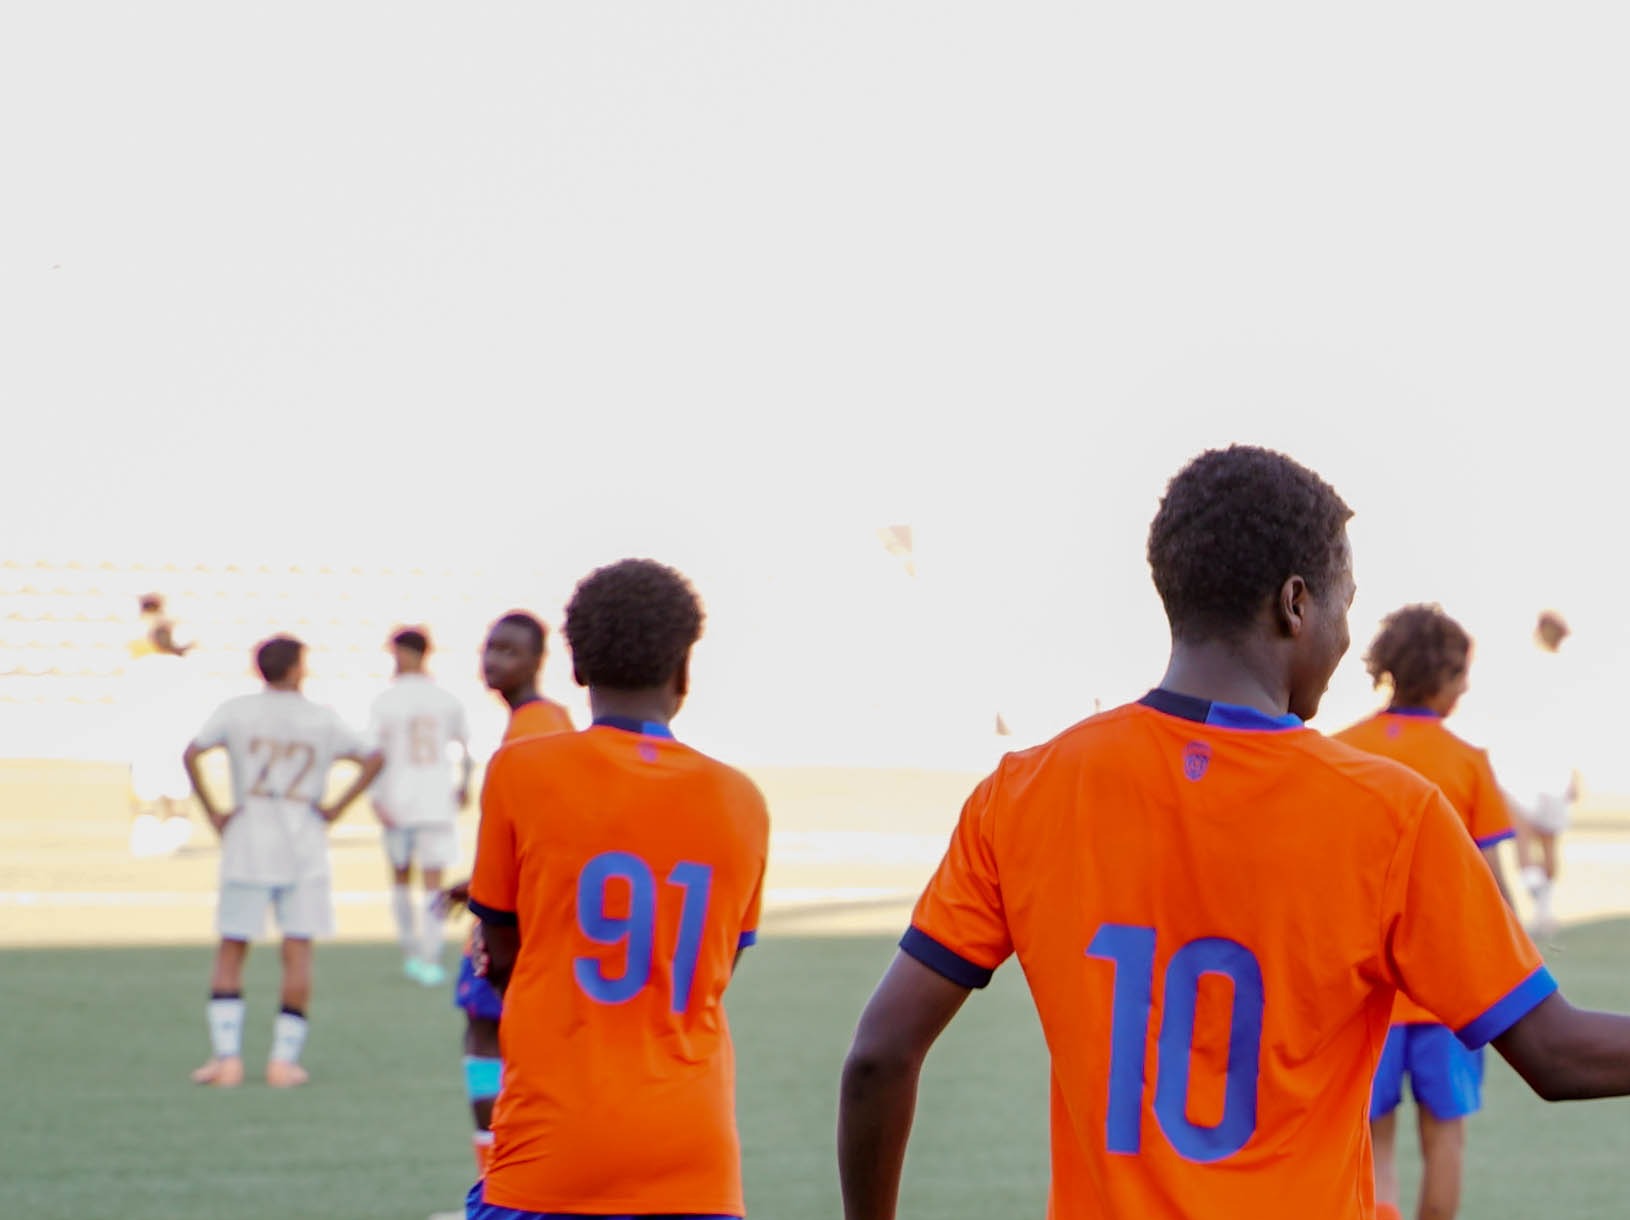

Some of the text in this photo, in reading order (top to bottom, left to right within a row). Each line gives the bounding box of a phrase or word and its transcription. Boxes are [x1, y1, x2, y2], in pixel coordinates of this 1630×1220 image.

[248, 737, 317, 799] 22
[573, 851, 713, 1014] 91
[1085, 923, 1265, 1162] 10
